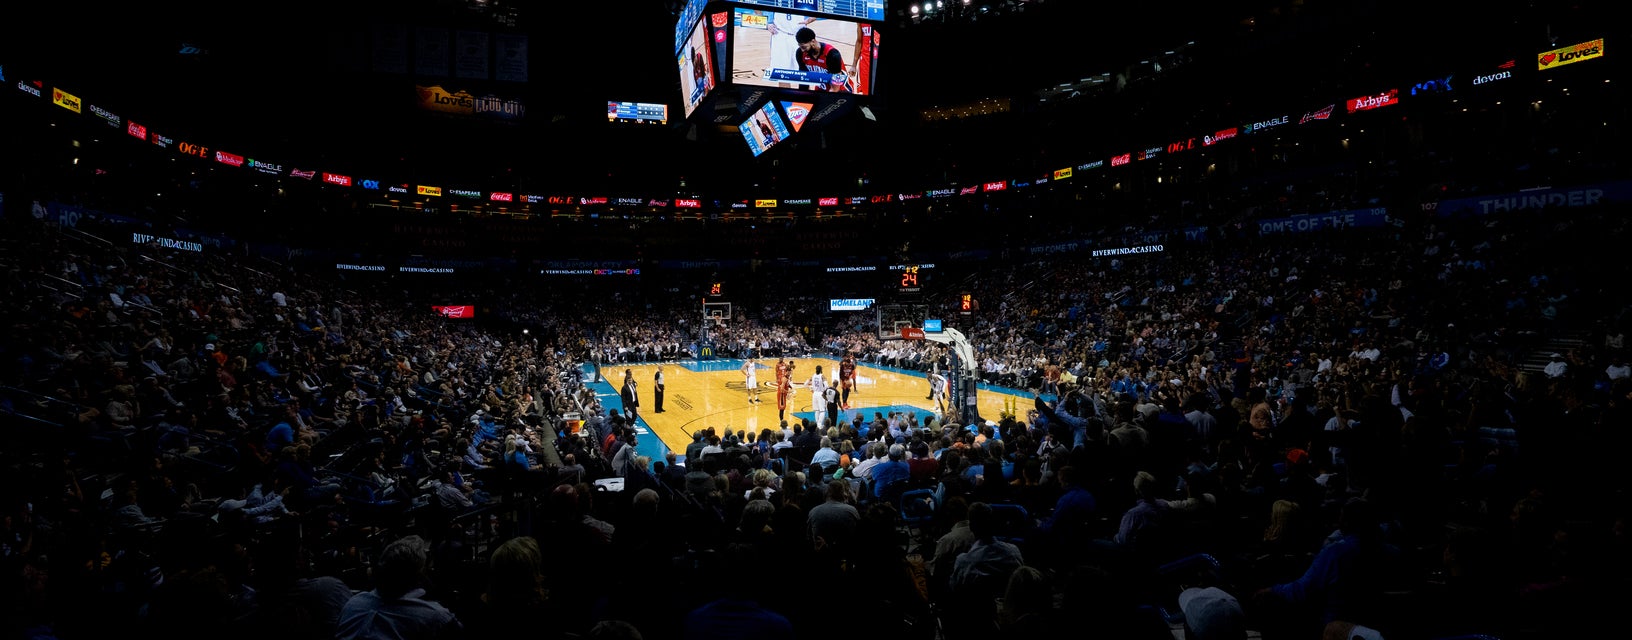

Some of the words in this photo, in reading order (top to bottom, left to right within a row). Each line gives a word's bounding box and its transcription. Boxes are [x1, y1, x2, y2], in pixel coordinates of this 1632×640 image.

[1473, 69, 1512, 85] devon
[1355, 92, 1390, 109] Arby's
[1253, 115, 1289, 131] ENABLE
[1167, 138, 1197, 154] OGE
[254, 160, 283, 172] ENABLE
[328, 174, 348, 185] Arby's
[1478, 188, 1603, 215] THUNDER
[1259, 220, 1294, 234] OME
[1296, 218, 1319, 232] OF
[902, 274, 917, 286] 24
